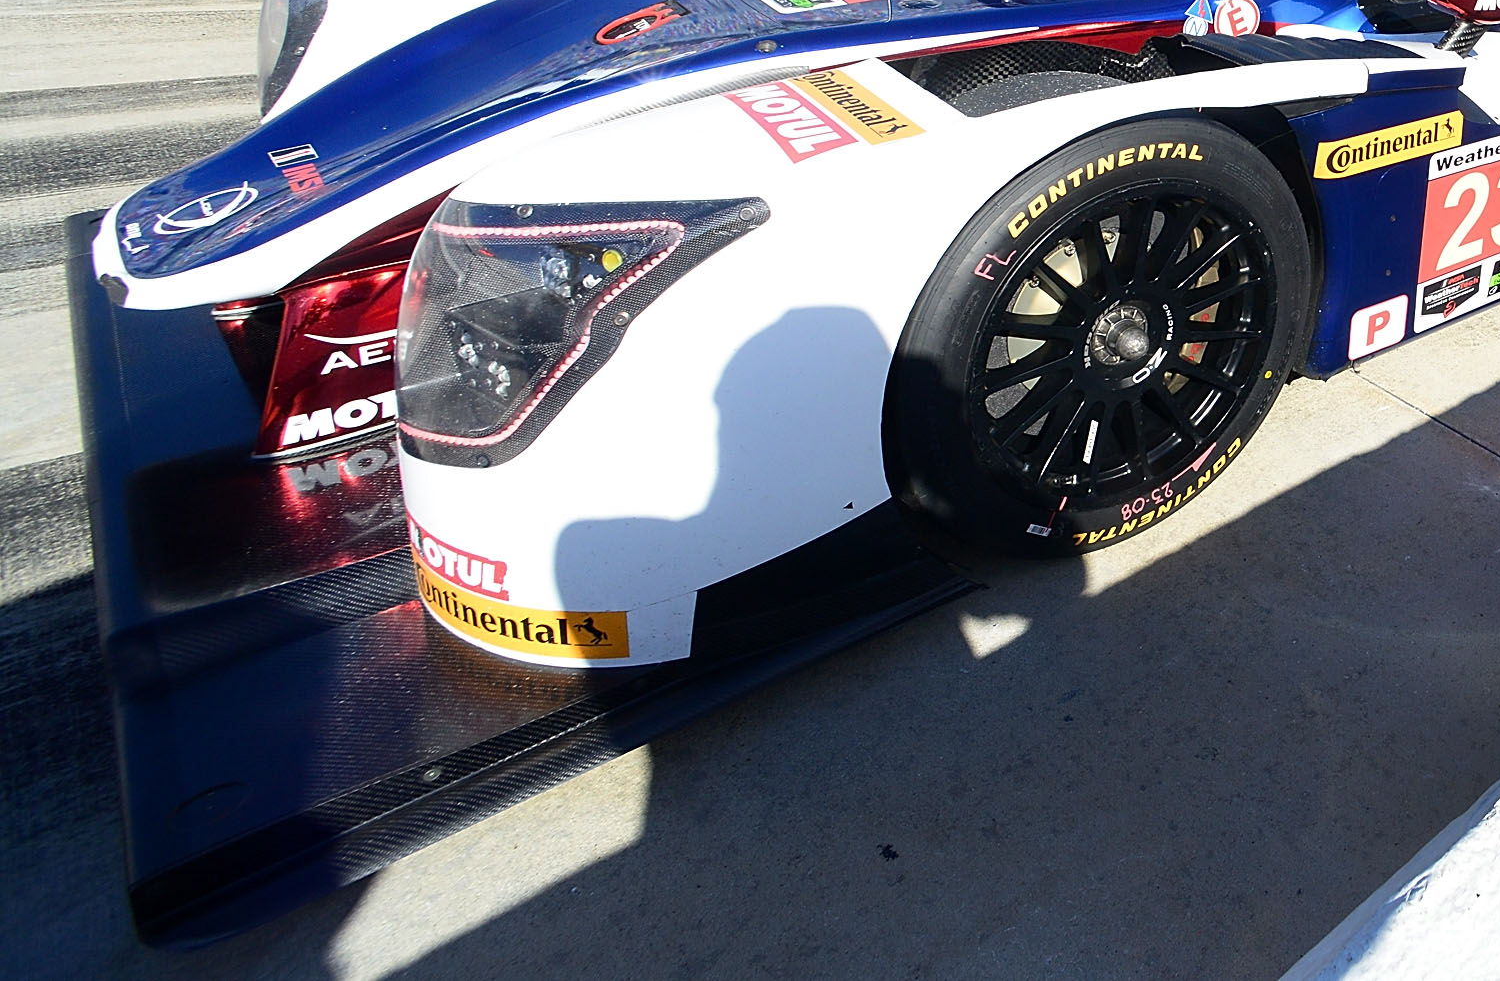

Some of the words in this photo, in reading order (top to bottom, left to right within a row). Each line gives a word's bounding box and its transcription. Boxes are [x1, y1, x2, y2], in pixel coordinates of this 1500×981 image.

[1227, 6, 1248, 37] E
[733, 83, 842, 155] MOTUL
[793, 71, 897, 128] Continental
[1325, 127, 1440, 174] Continental
[1007, 142, 1204, 239] CONTINENTAL
[974, 248, 1016, 282] FL
[1365, 310, 1391, 347] P
[282, 389, 398, 446] MOT
[1072, 437, 1242, 547] CONTINENTAL
[416, 563, 572, 647] Continental
